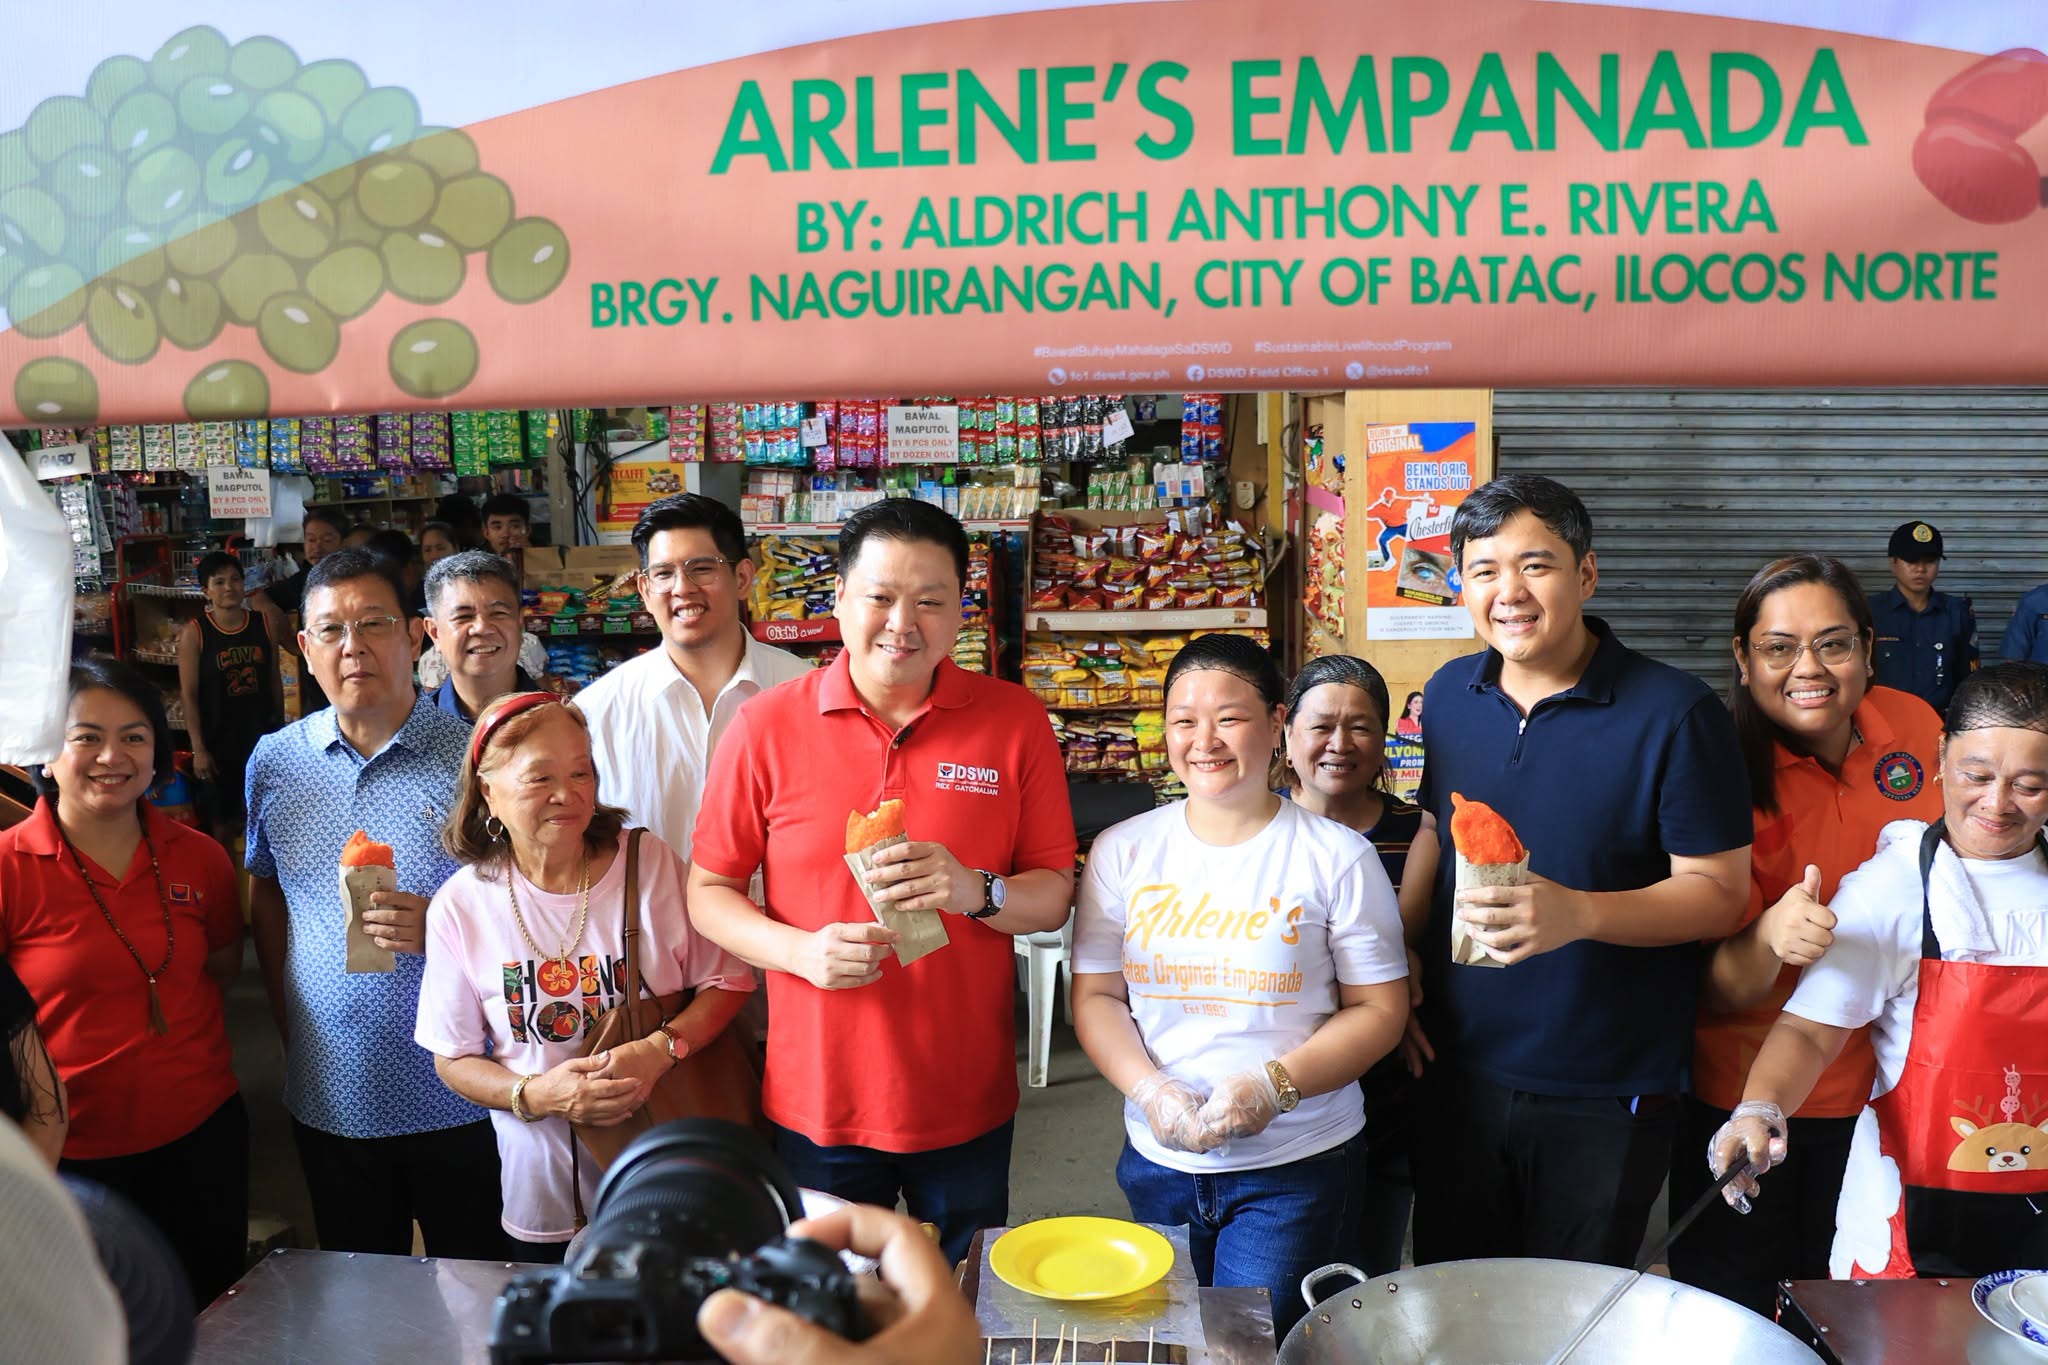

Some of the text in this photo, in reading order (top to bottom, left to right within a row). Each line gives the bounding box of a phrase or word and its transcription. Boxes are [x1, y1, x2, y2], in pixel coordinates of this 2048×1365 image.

[710, 47, 1870, 176] ARLENE'S EMPANADA
[797, 178, 1779, 254] BY: ALDRICH ANTHONY E. RIVERA
[591, 251, 1998, 329] BRGY. NAGUIRANGAN, CITY OF BATAC, ILOCOS NORTE
[1207, 367, 1245, 378] DSWD
[1250, 367, 1280, 377] Field
[1283, 366, 1318, 377] Office
[905, 412, 940, 420] BAWAL
[895, 426, 950, 434] MAGPUTOL
[892, 439, 903, 447] BY
[931, 439, 953, 447] ONLY
[934, 450, 956, 458] ONLY
[1406, 463, 1438, 476] BEING
[215, 484, 263, 492] MAGPUTOL
[1406, 477, 1471, 490] STANDS OUT
[1409, 516, 1452, 541] Chesterfi
[766, 625, 799, 641] Oishi
[1400, 758, 1425, 767] PROM
[956, 764, 999, 783] DSWD
[1126, 883, 1303, 951] Arlene's
[1154, 953, 1217, 991] Original
[1222, 957, 1303, 993] Empanada
